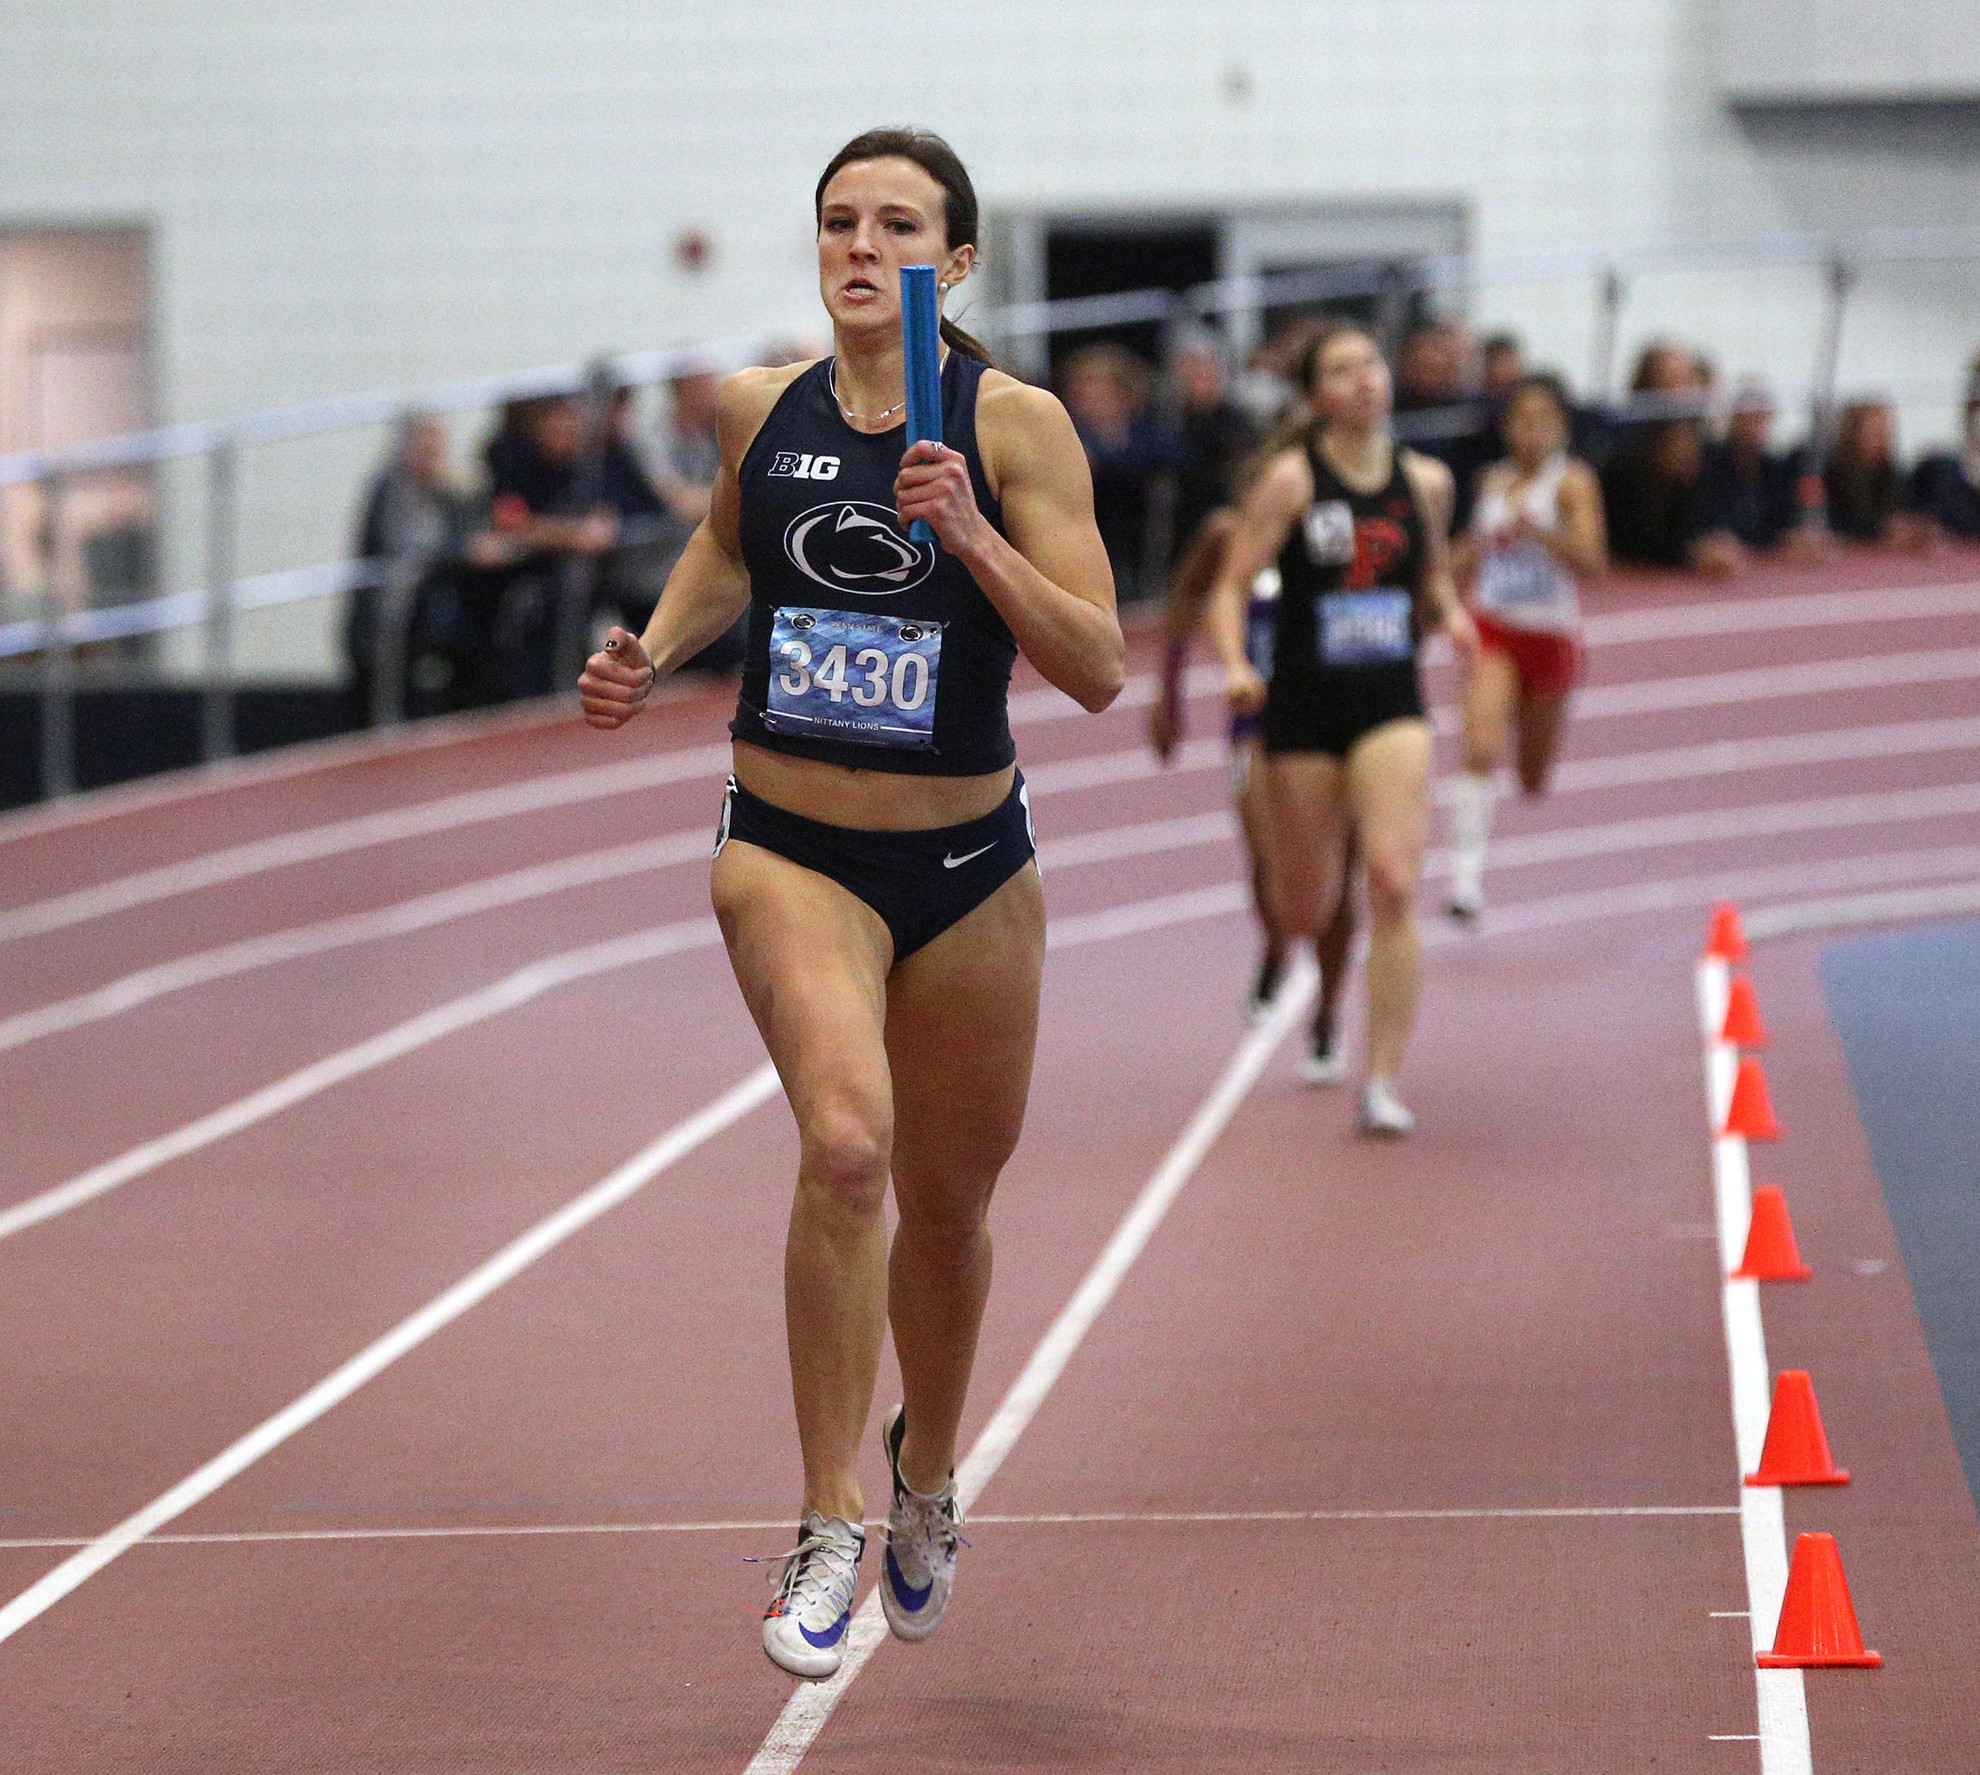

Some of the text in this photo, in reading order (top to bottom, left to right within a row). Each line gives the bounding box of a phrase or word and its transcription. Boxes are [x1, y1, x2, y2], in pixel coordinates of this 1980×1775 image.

[780, 640, 929, 710] 3430
[813, 717, 879, 730] NITTANY LIONS
